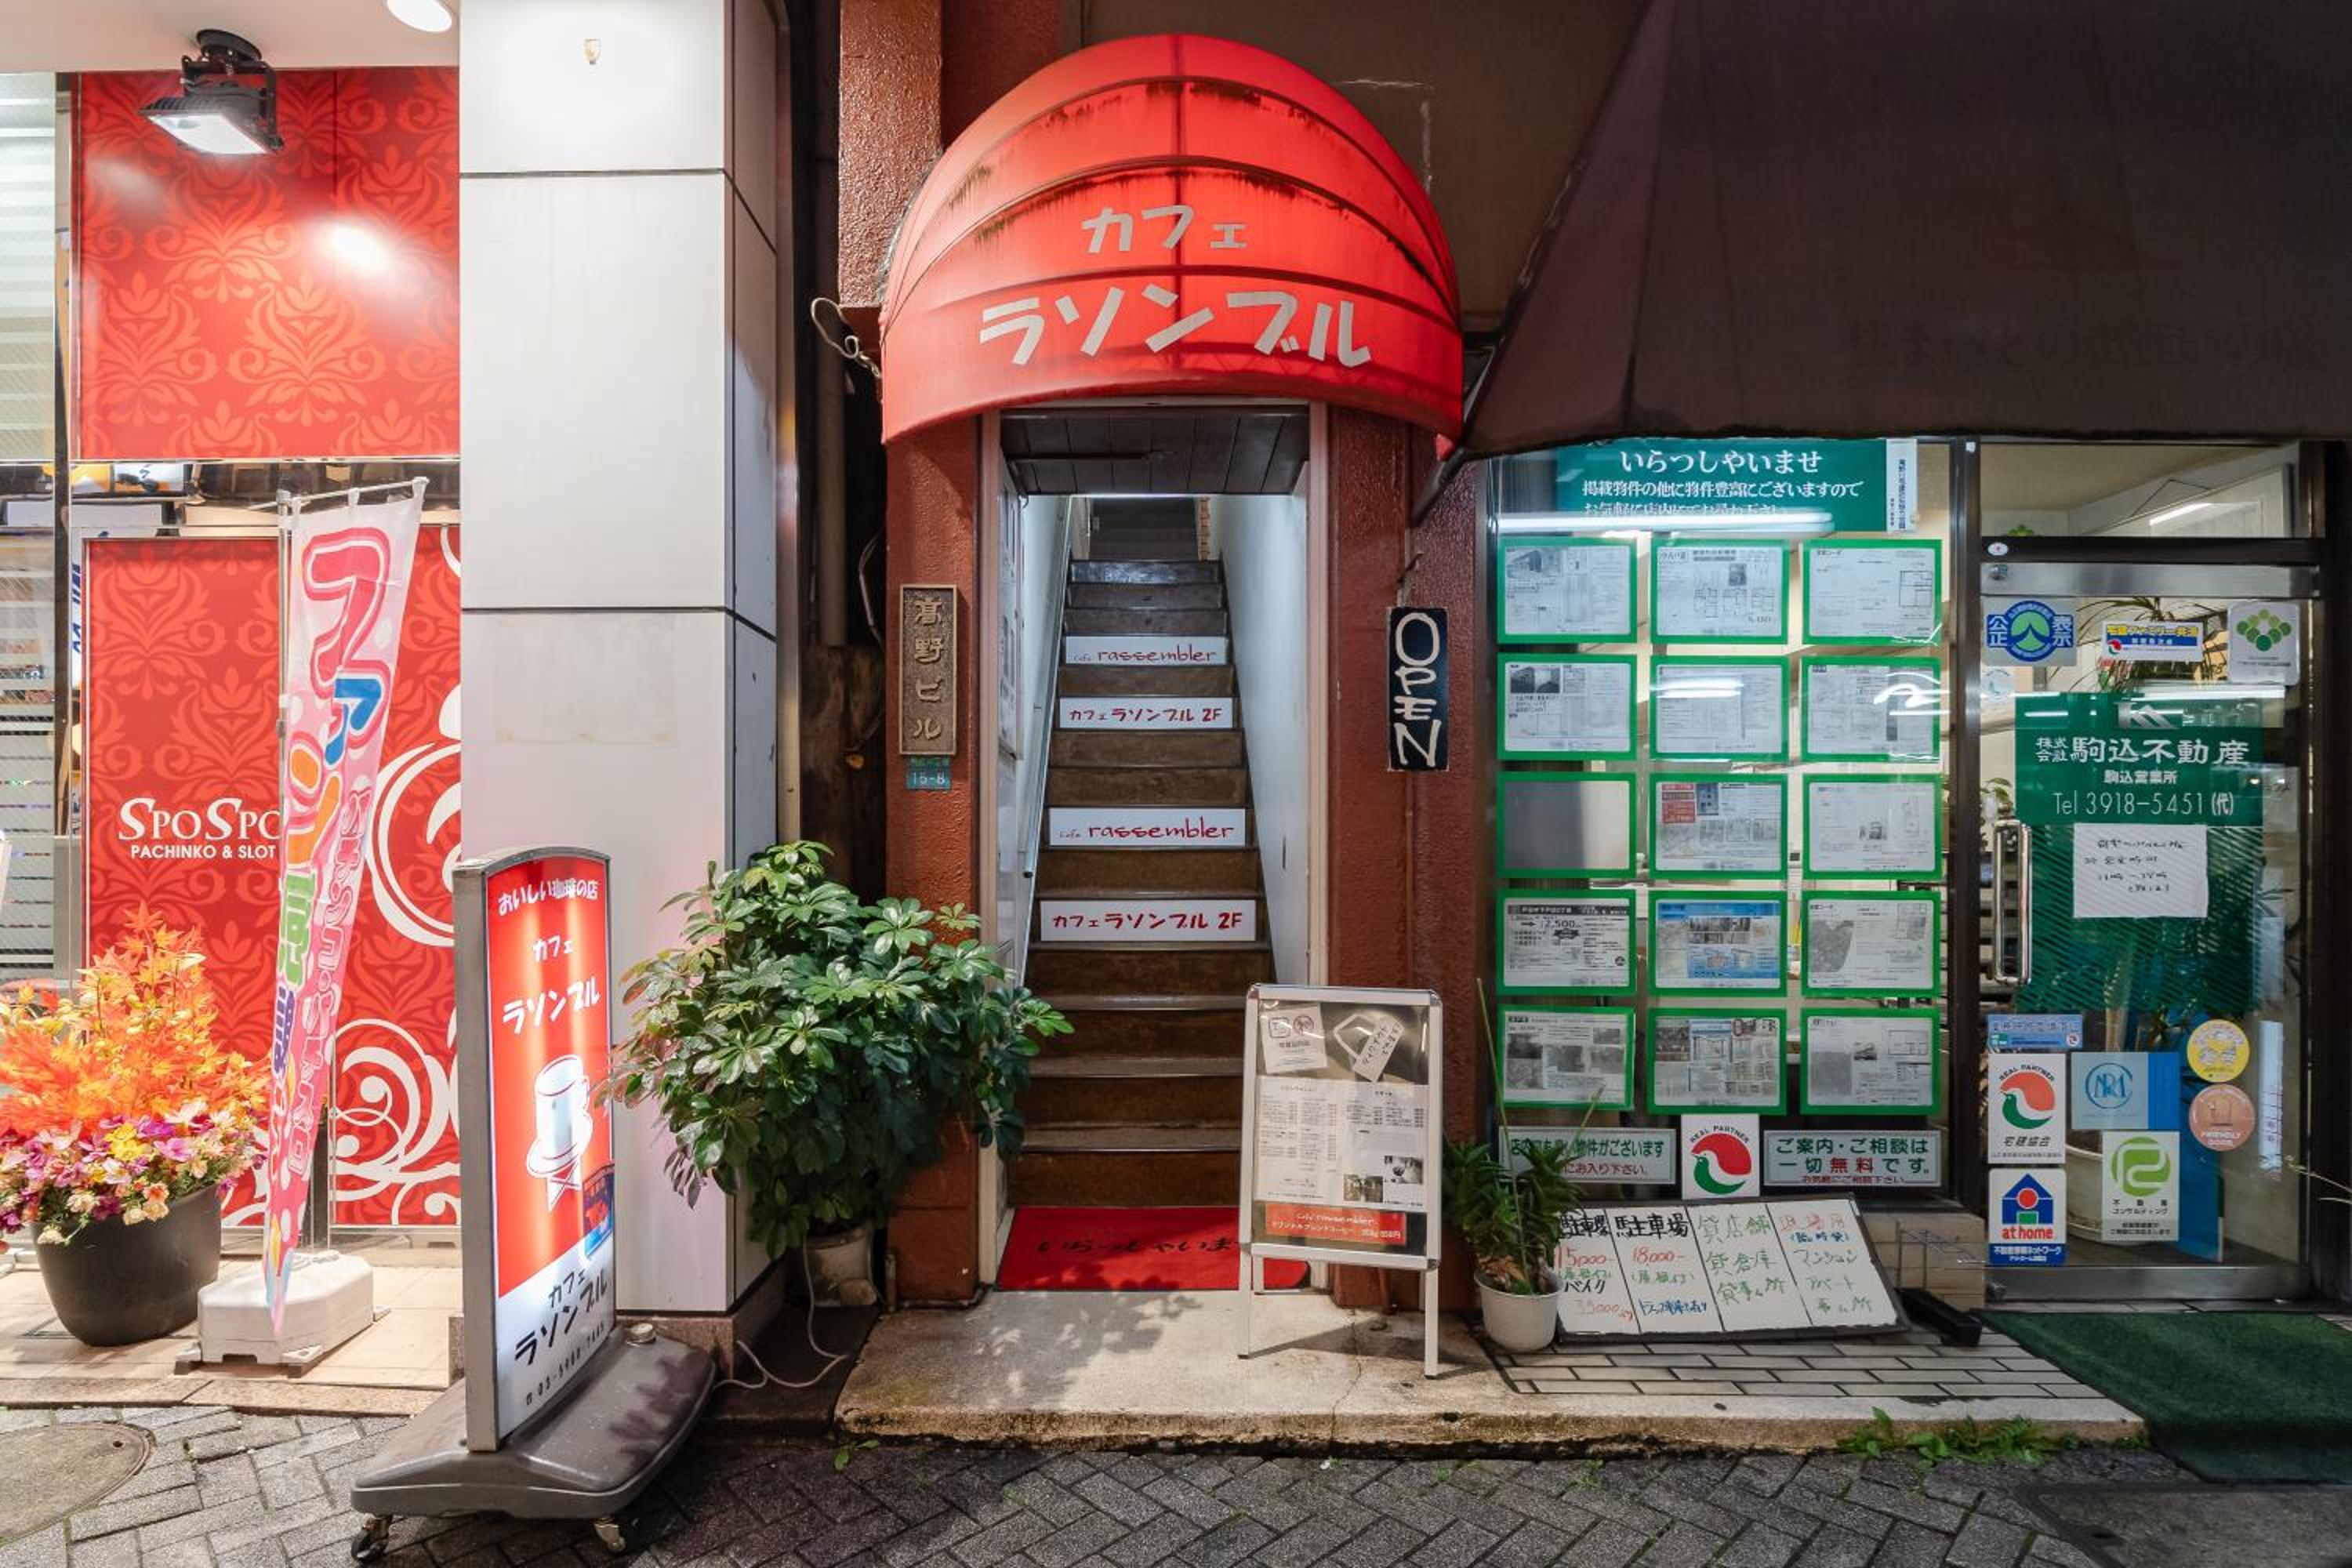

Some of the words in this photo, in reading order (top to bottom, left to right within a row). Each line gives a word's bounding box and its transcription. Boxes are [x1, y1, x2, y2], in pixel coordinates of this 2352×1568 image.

[1081, 205, 1247, 253] カフェ
[979, 285, 1372, 366] ラソンブル
[1582, 480, 1863, 498] 掲載物件の他に物件豊富にございますので
[1989, 615, 2009, 647] 公正
[2052, 615, 2072, 647] 表示
[1097, 644, 1216, 662] rassembler
[1393, 612, 1442, 768] OPEN
[1203, 708, 1222, 721] 2F
[2071, 737, 2250, 766] 駒込不動産
[2103, 769, 2178, 785] 駒込営業所
[2054, 789, 2078, 815] Tel
[2085, 792, 2203, 815] 3918-5451
[1088, 816, 1235, 838] rassembler
[131, 845, 216, 858] PACHINKO
[222, 845, 233, 858] &
[238, 845, 275, 858] SLOT
[498, 878, 598, 916] おいしい珈琲の店
[1218, 913, 1243, 929] 2F
[532, 935, 573, 962] カフェ
[1776, 1138, 1928, 1155] ご案内・ご相談は
[1614, 1213, 1690, 1239] 駐車場
[2002, 1229, 2016, 1240] at
[2019, 1228, 2053, 1240] home
[1034, 1236, 1240, 1254] いらっしゃいま
[1793, 1248, 1858, 1267] マンション
[548, 1268, 586, 1308] カフェ
[1564, 1279, 1606, 1294] バイク
